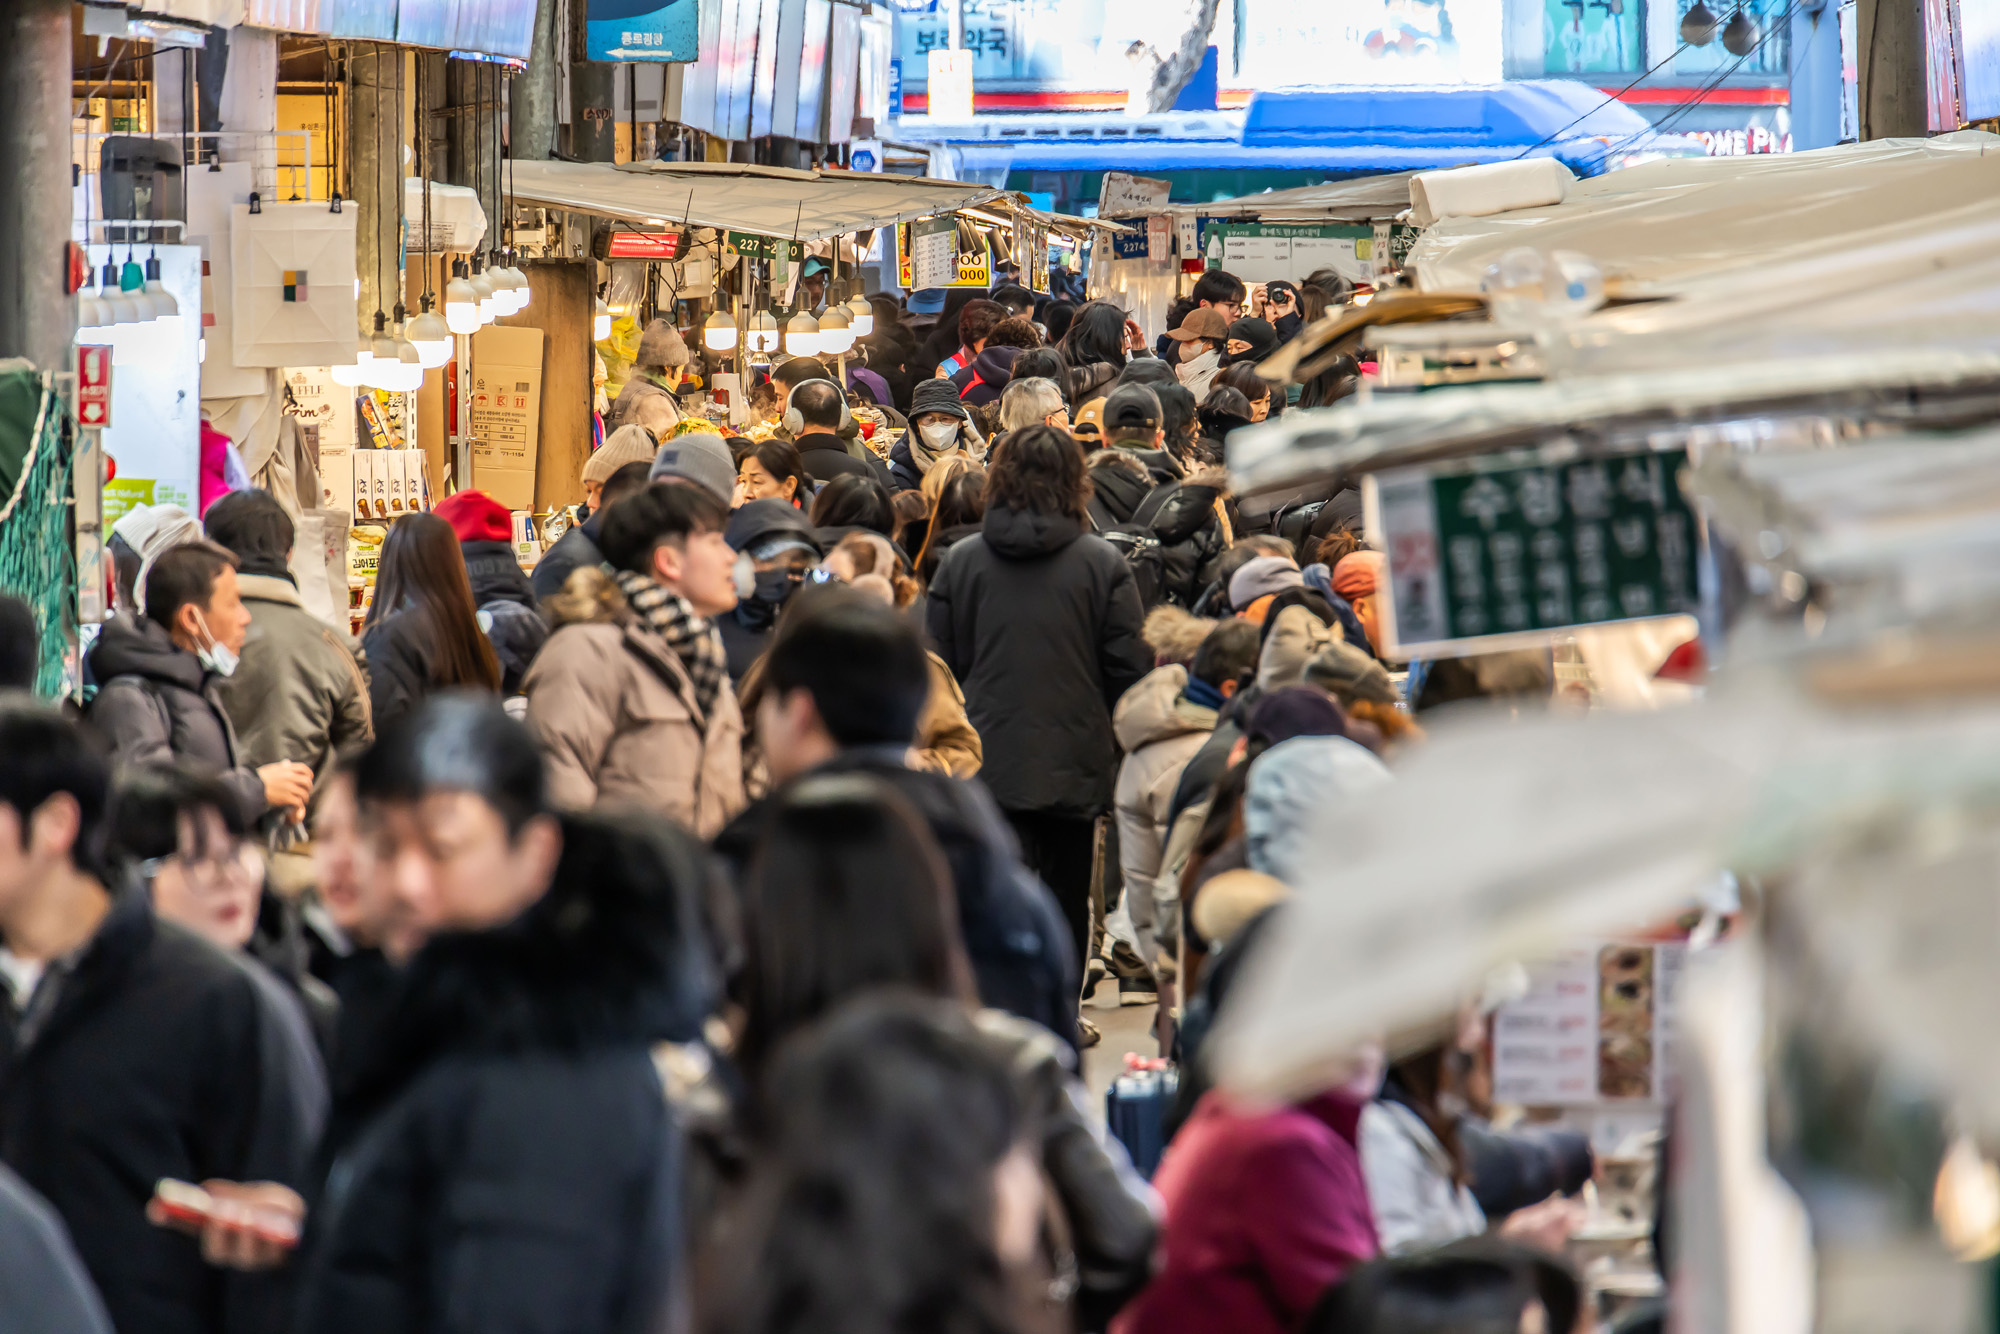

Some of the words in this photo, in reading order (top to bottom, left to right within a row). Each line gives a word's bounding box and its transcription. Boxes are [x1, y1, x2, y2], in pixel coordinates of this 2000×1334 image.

[1102, 236, 1108, 244] 3
[740, 238, 798, 257] 227-20
[960, 269, 985, 281] 000
[290, 384, 325, 395] UFFLE
